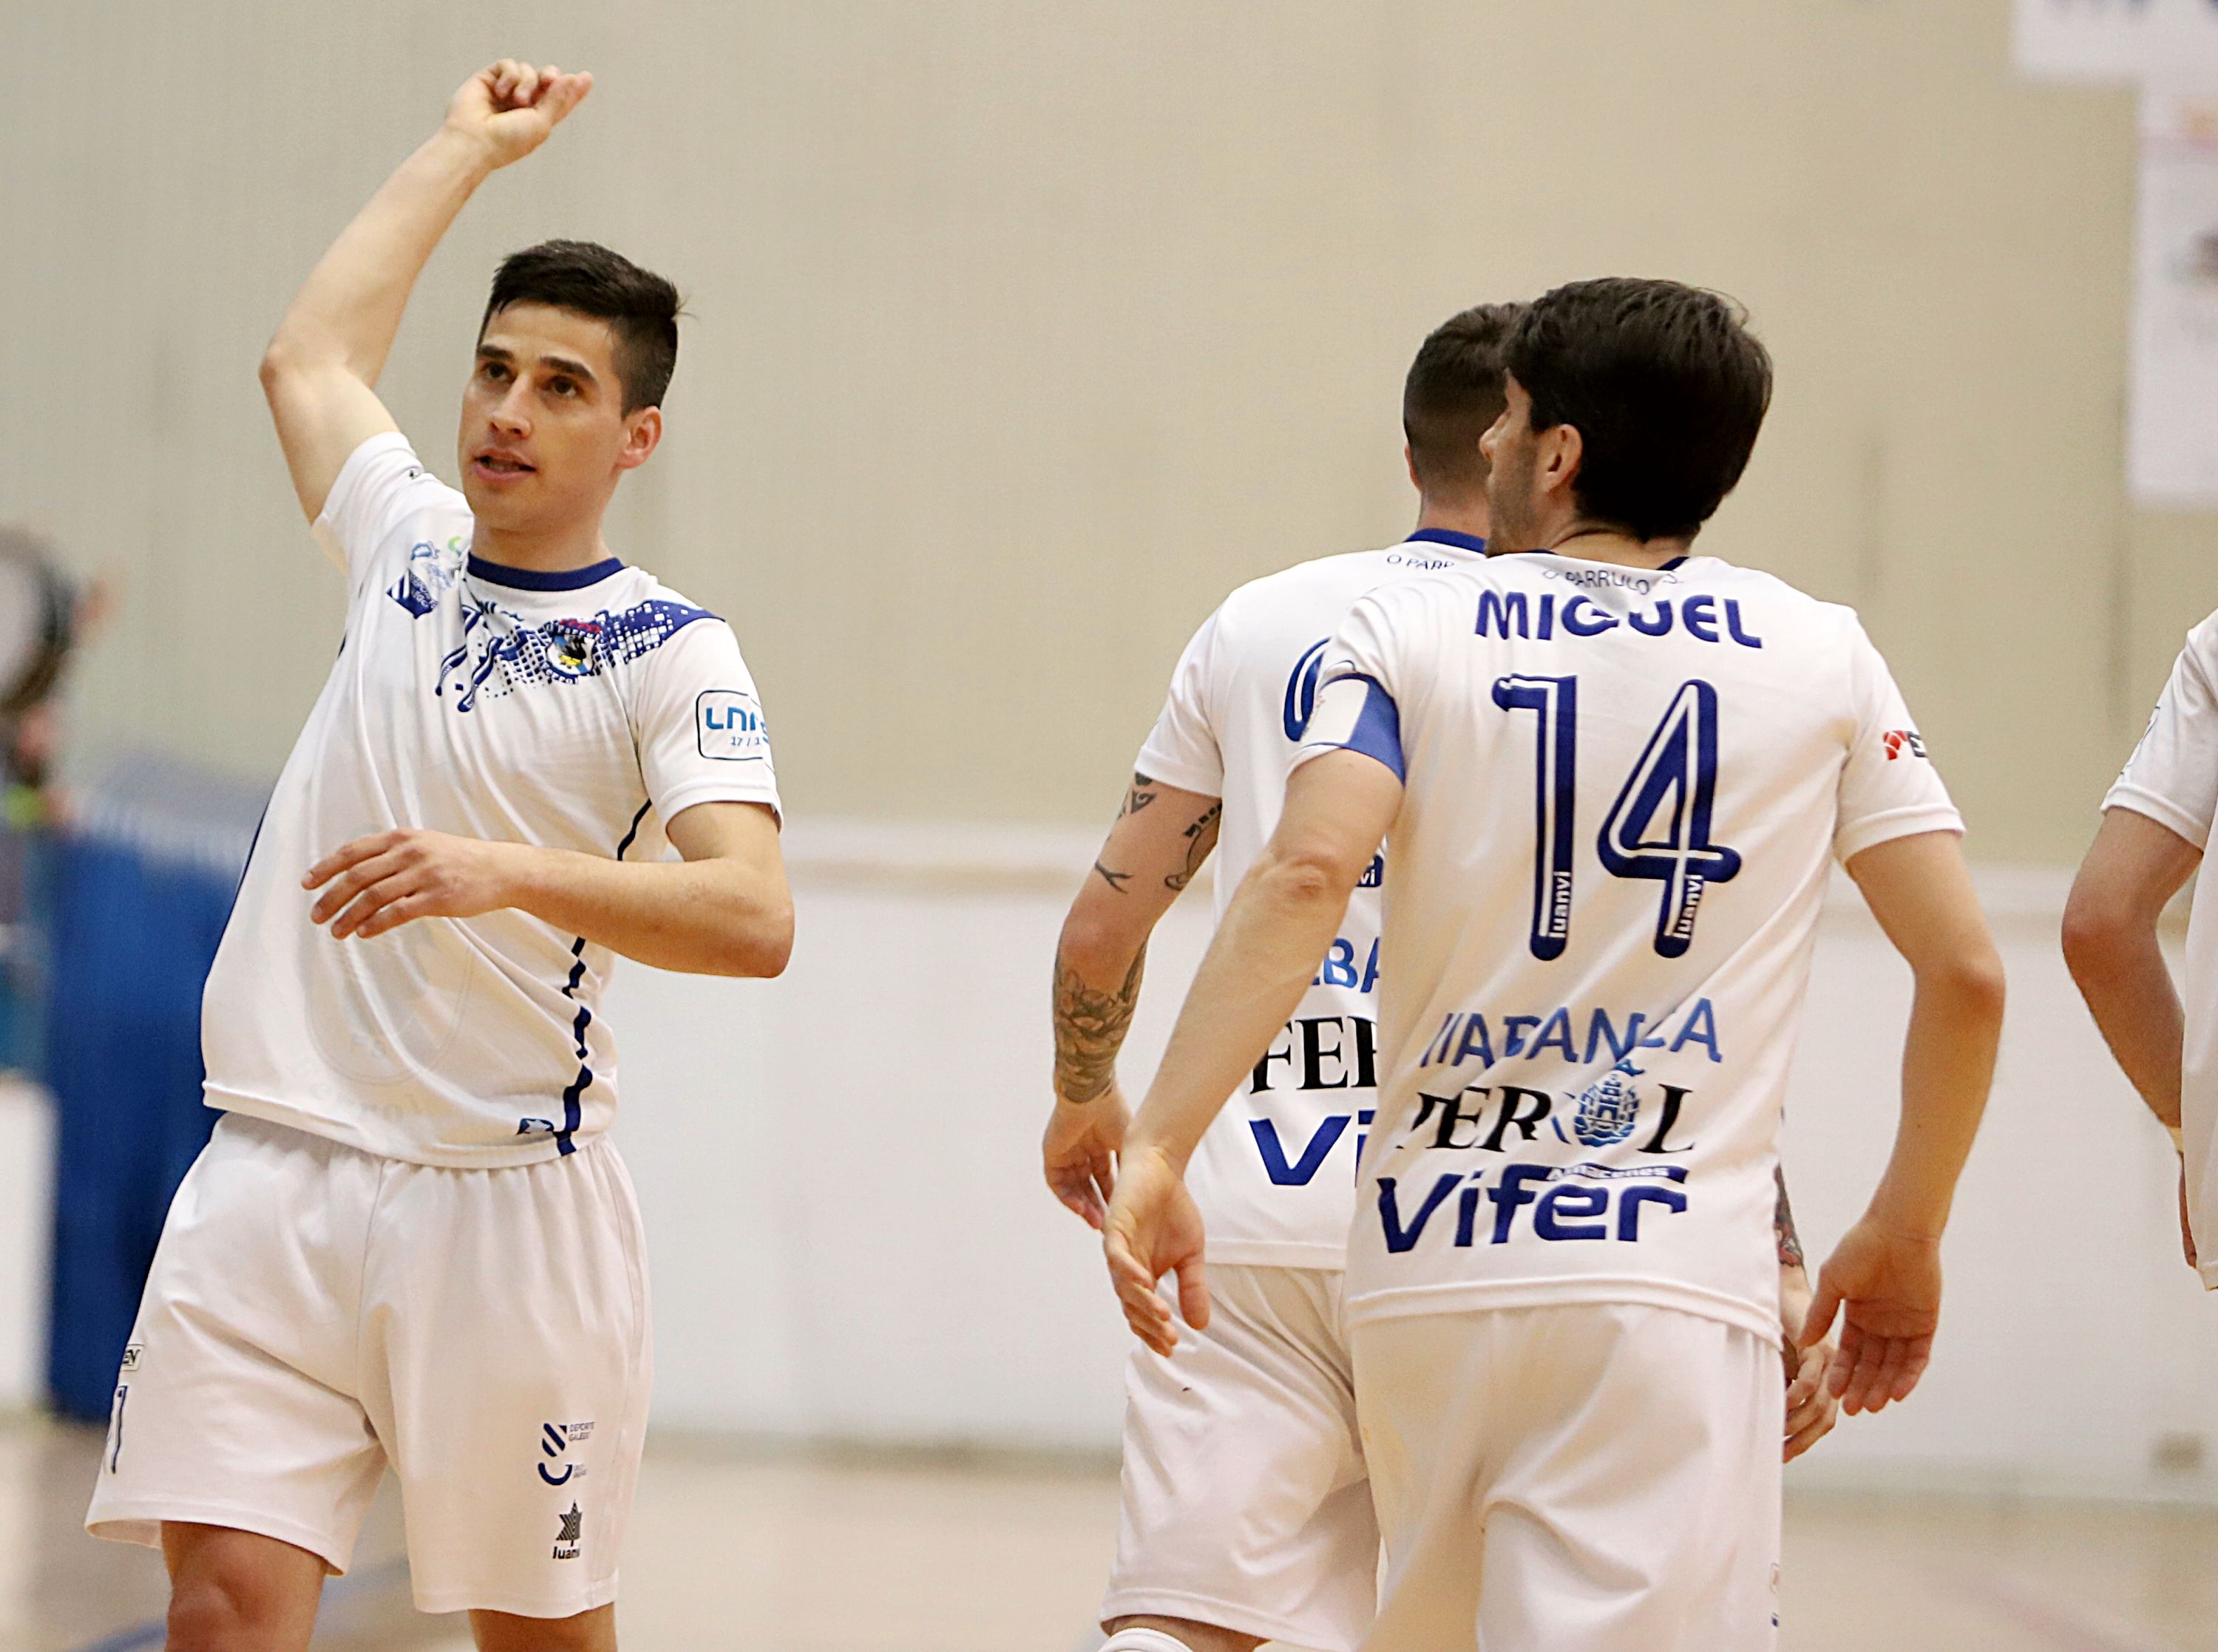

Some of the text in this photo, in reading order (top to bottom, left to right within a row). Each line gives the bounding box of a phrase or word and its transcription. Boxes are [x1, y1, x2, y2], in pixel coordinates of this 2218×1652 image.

[1474, 589, 1763, 648] MIGUEL
[1491, 673, 1742, 961] 14
[1548, 870, 1573, 939] luanvi
[1672, 874, 1704, 939] luanvi
[1375, 1163, 1689, 1254] Vifer
